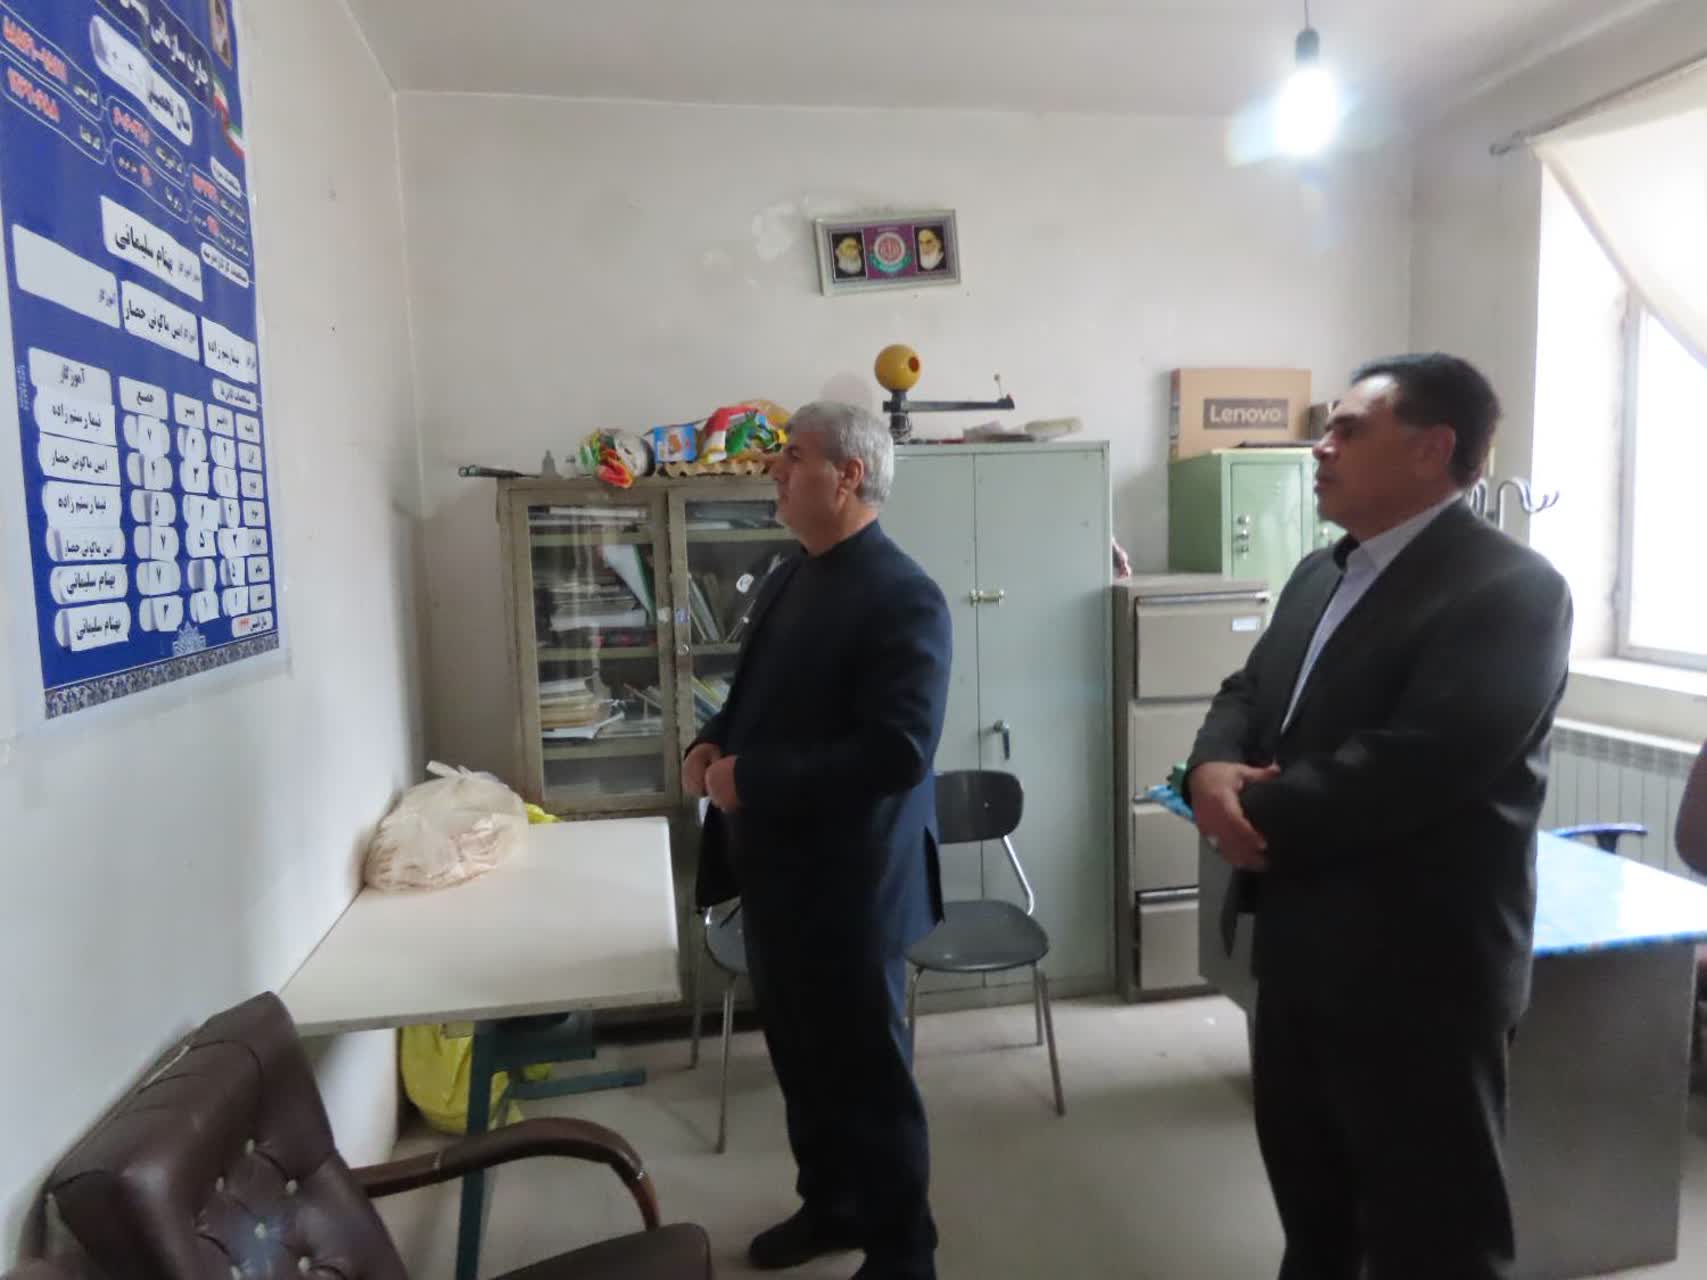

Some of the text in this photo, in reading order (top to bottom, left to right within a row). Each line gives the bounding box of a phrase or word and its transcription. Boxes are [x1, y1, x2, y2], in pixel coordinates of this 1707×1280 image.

[114, 223, 155, 260] سلیمانی
[1209, 404, 1282, 424] Lenovo
[50, 448, 71, 467] حصار
[159, 532, 166, 551] ۷
[66, 569, 116, 596] بهنام سلیمانی
[156, 565, 163, 585] ۷
[76, 615, 122, 642] بهنام سلیمانی
